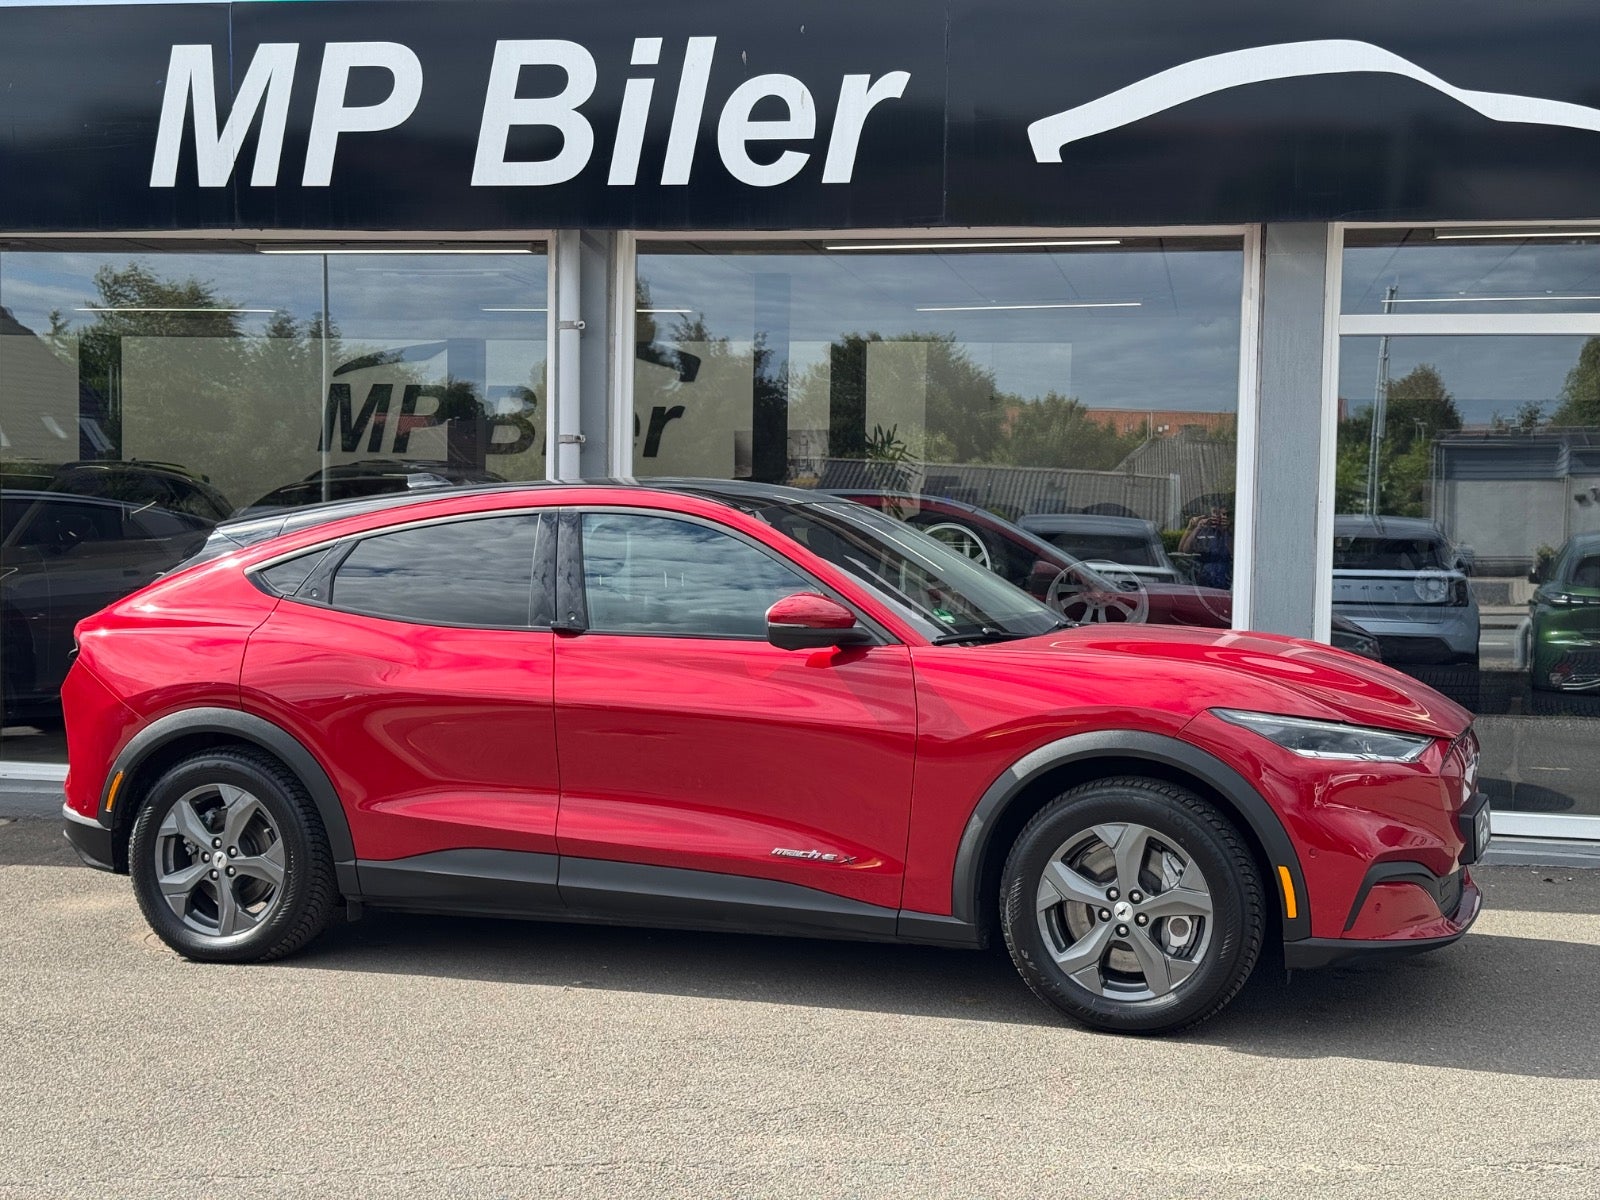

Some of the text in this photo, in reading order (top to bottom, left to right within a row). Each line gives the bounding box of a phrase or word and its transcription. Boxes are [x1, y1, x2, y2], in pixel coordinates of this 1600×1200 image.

[150, 37, 911, 187] MP Biler
[318, 383, 449, 454] MP
